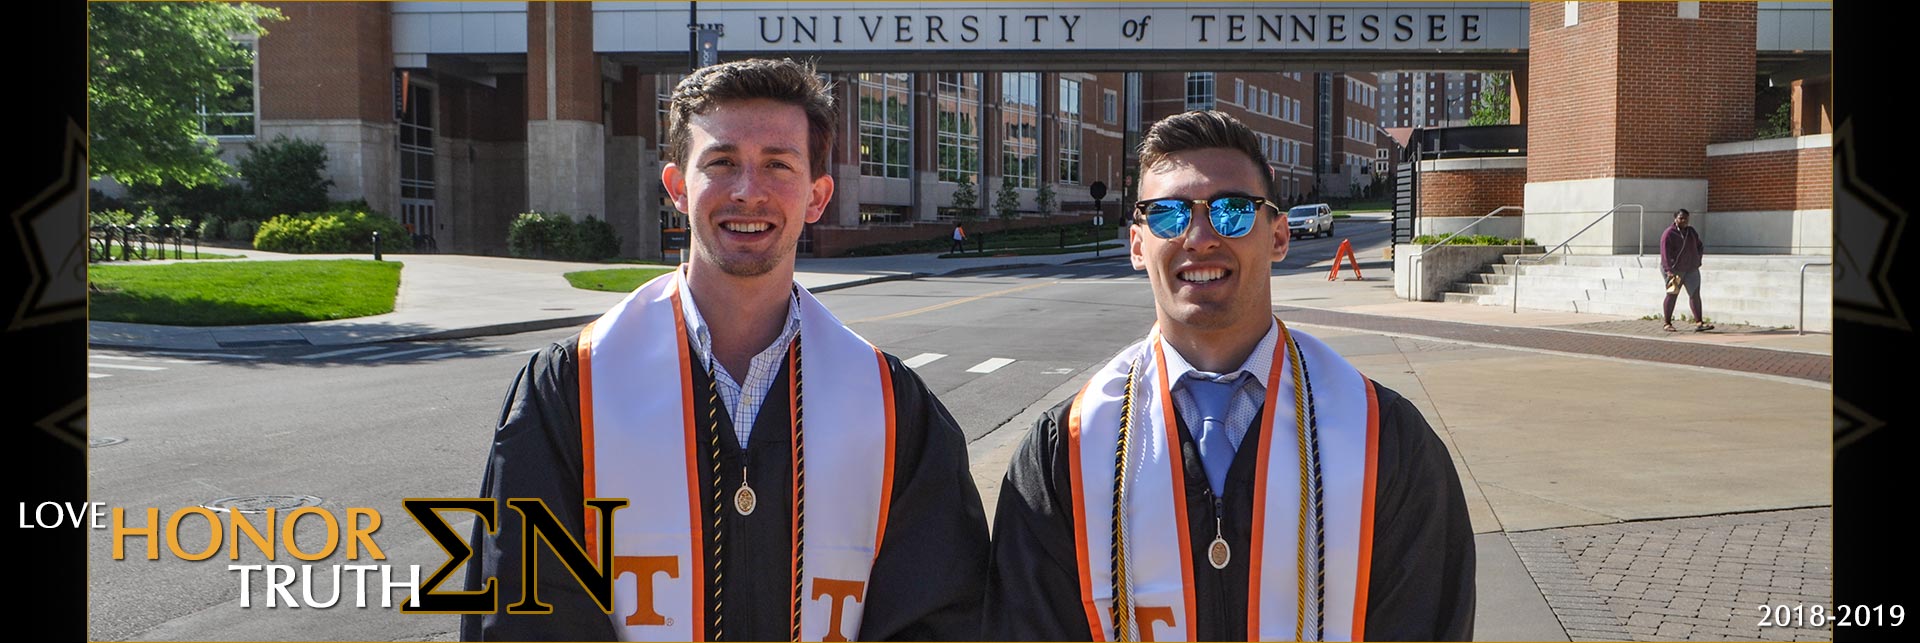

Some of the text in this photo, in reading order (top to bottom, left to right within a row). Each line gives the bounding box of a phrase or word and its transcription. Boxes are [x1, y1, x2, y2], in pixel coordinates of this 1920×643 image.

[758, 15, 1082, 43] UNIVERSITY
[1122, 15, 1152, 42] of
[1191, 14, 1482, 43] TENNESSEE
